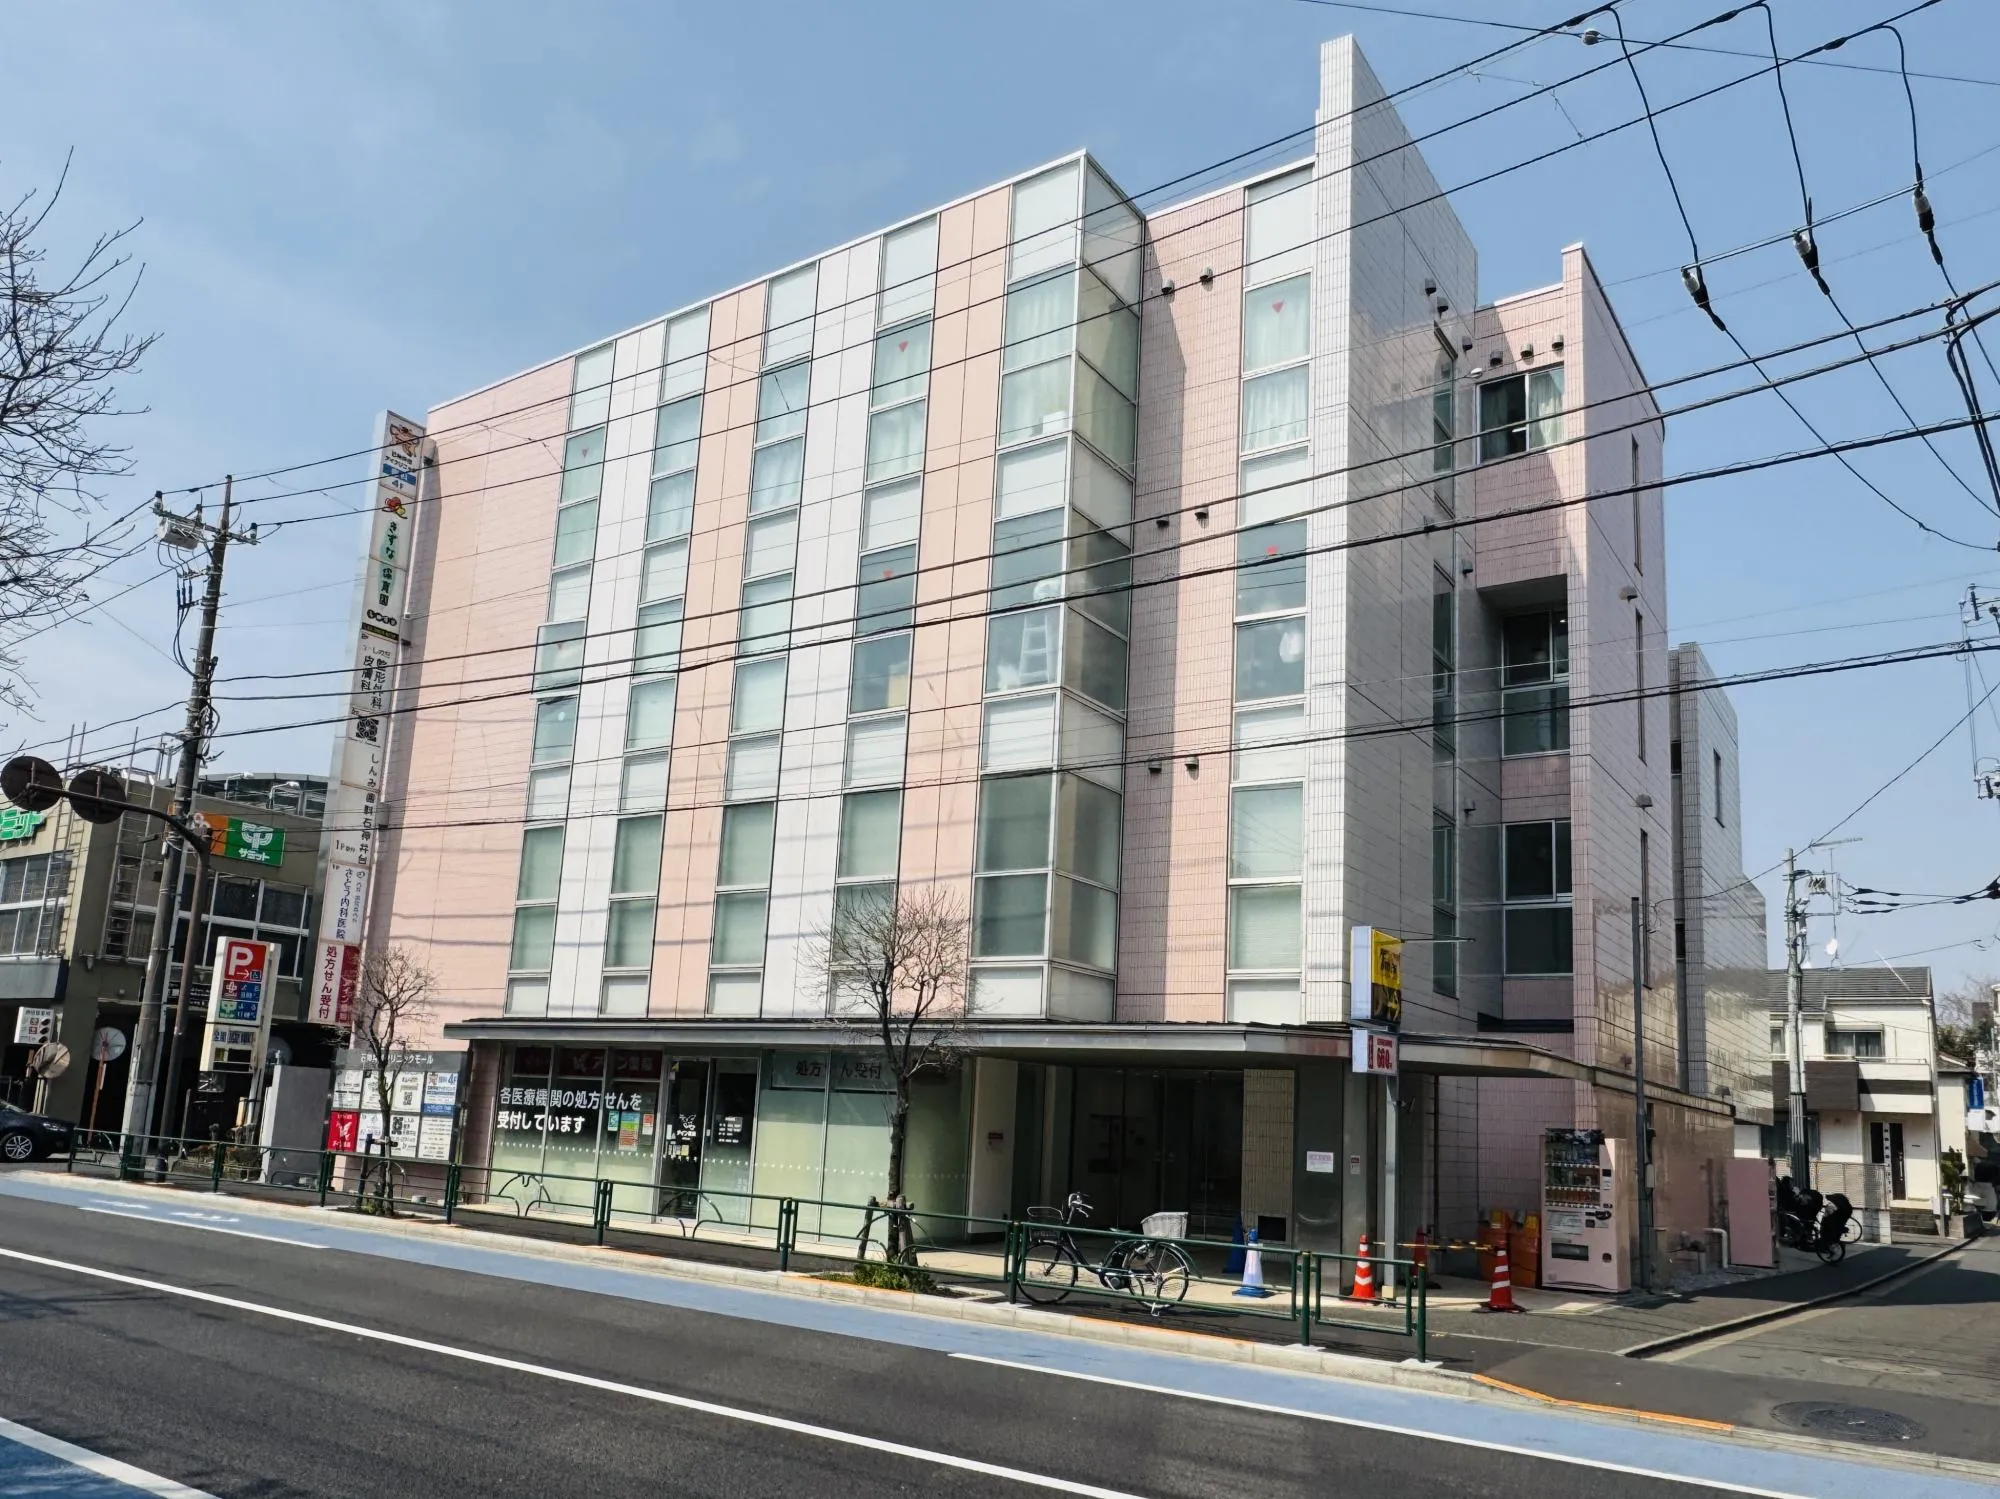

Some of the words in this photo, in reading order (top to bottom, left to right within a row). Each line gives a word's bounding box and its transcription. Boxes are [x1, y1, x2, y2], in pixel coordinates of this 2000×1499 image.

[238, 847, 271, 861] サミット
[335, 868, 354, 940] さとう内科医院
[228, 945, 254, 976] P
[319, 946, 338, 1020] 処方せん受付
[796, 1060, 882, 1080] 処方ん受付
[500, 1086, 642, 1111] 各医療機関の処方せんを
[497, 1110, 586, 1134] 受付しています
